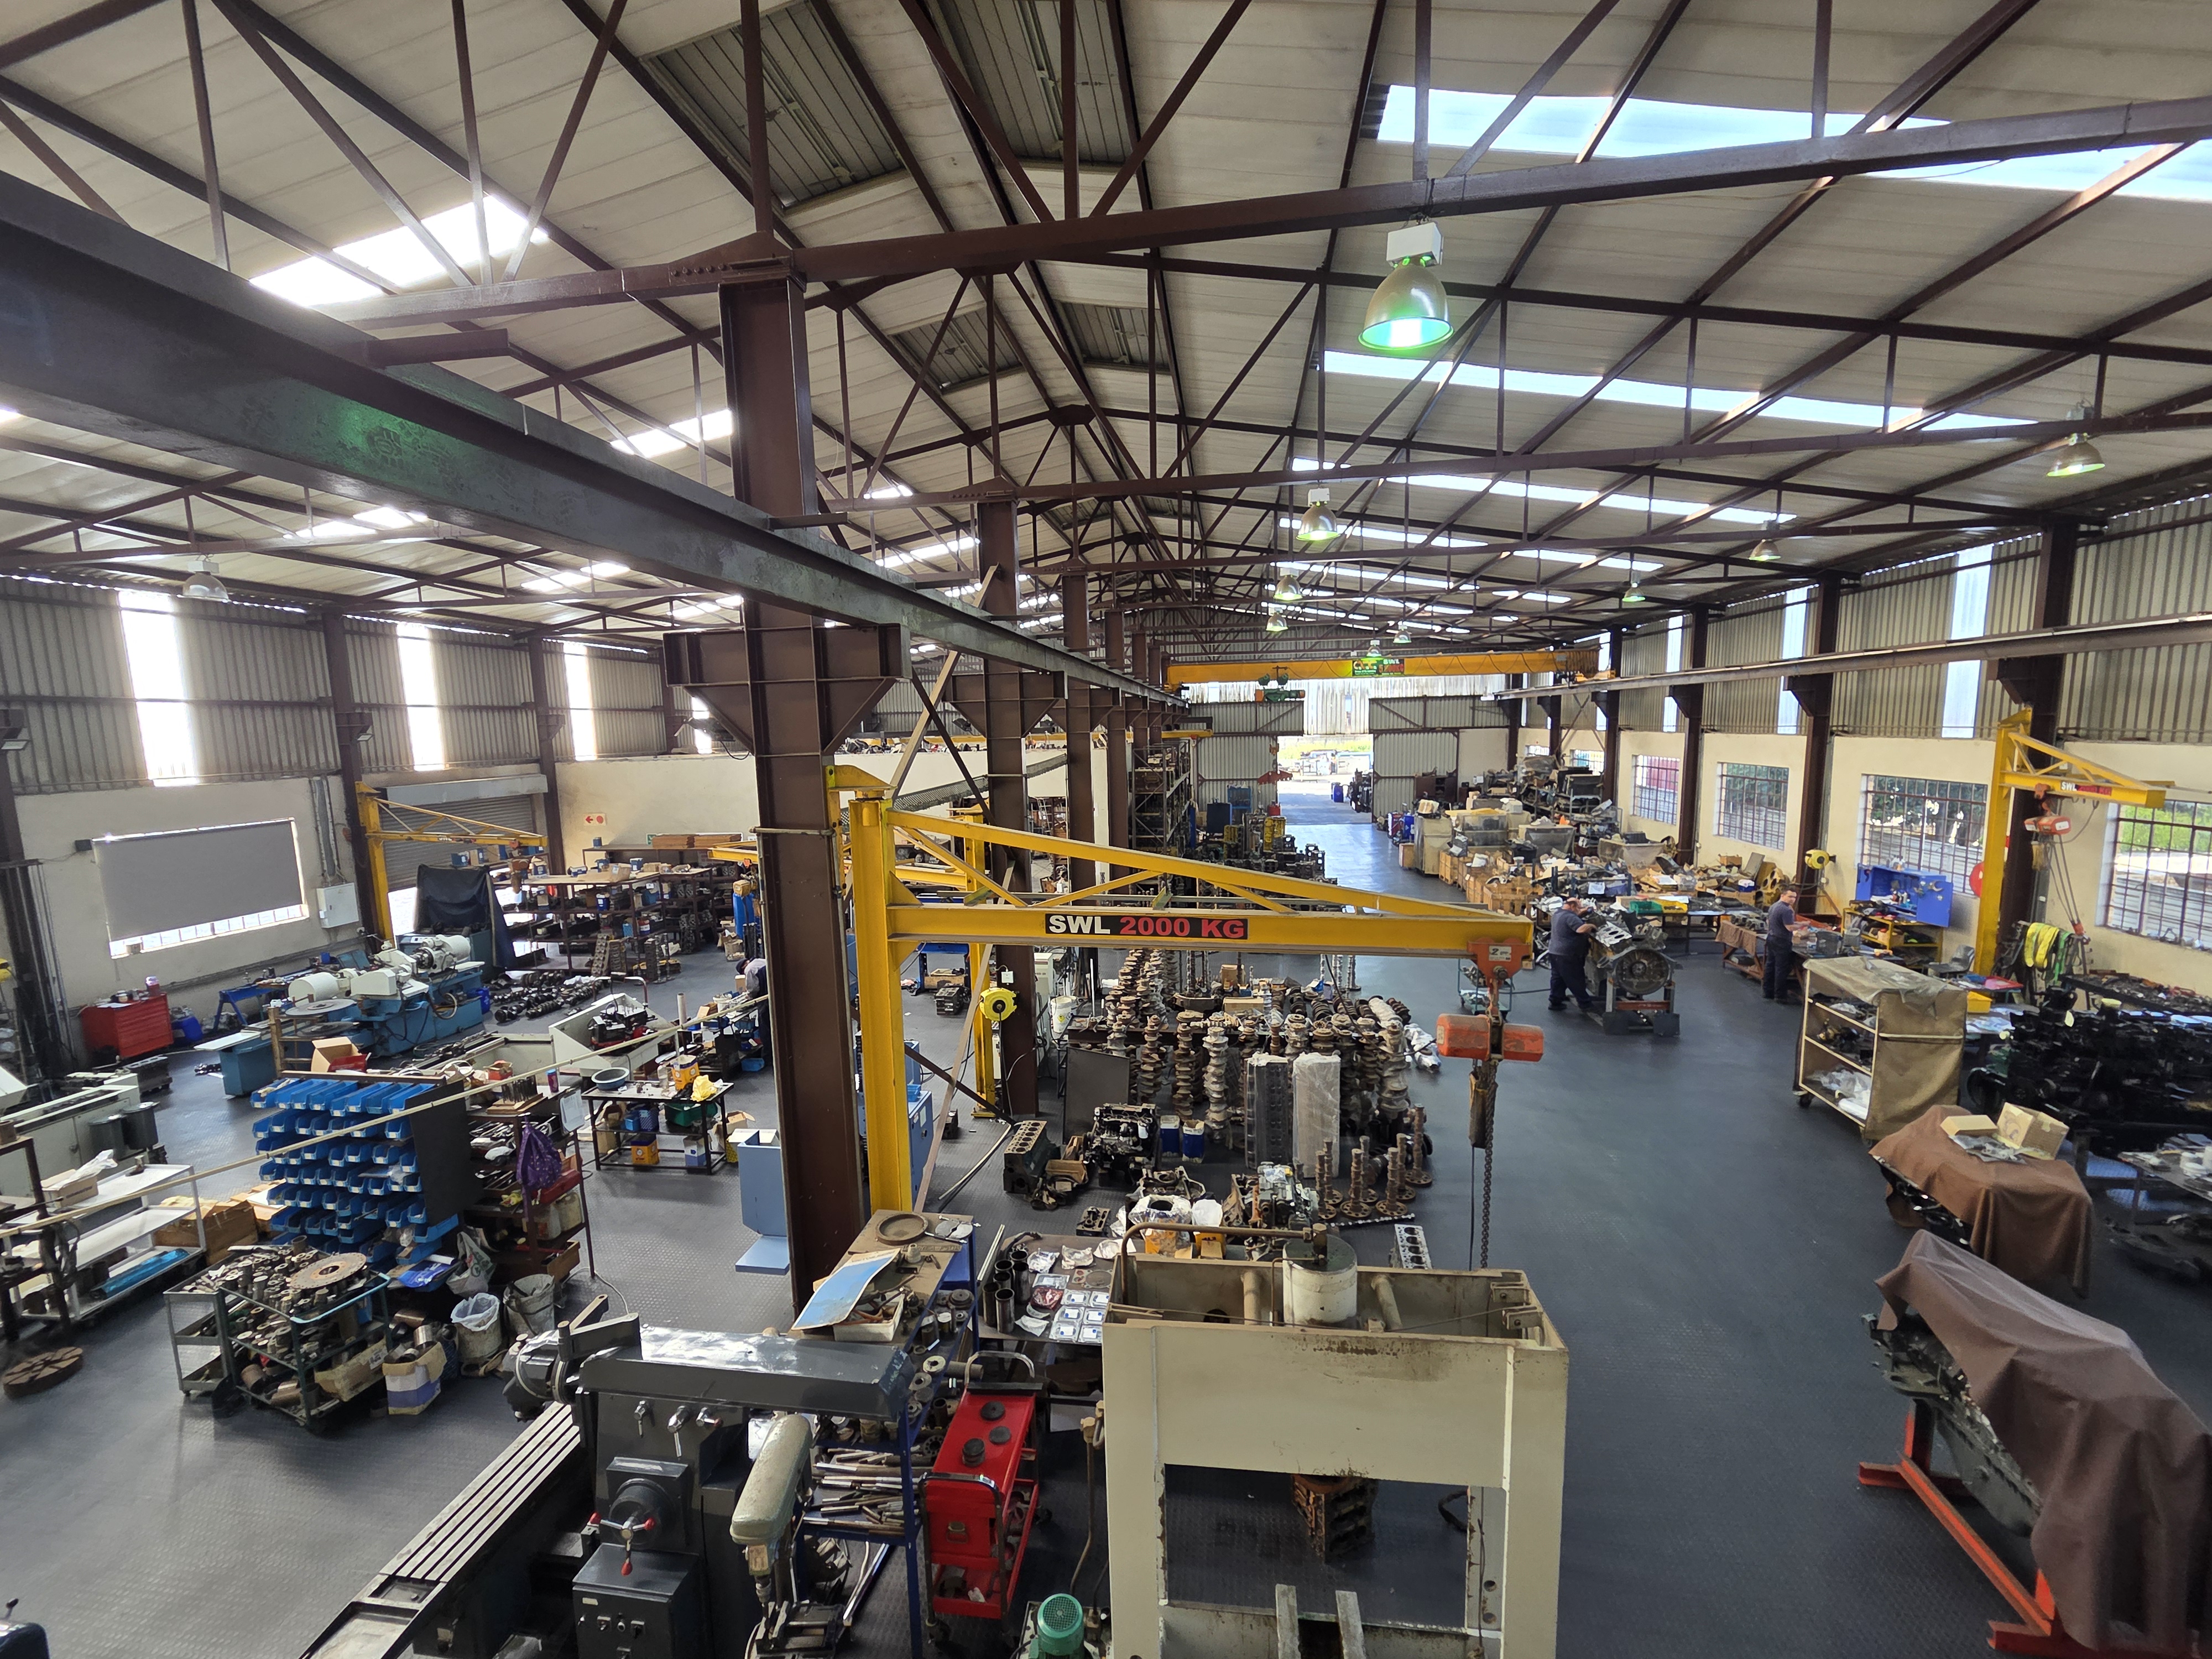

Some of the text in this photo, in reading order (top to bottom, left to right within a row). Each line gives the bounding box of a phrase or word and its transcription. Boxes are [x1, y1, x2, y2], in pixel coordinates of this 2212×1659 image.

[2061, 781, 2077, 791] SWL
[1049, 915, 1244, 938] SWL 2000 KG
